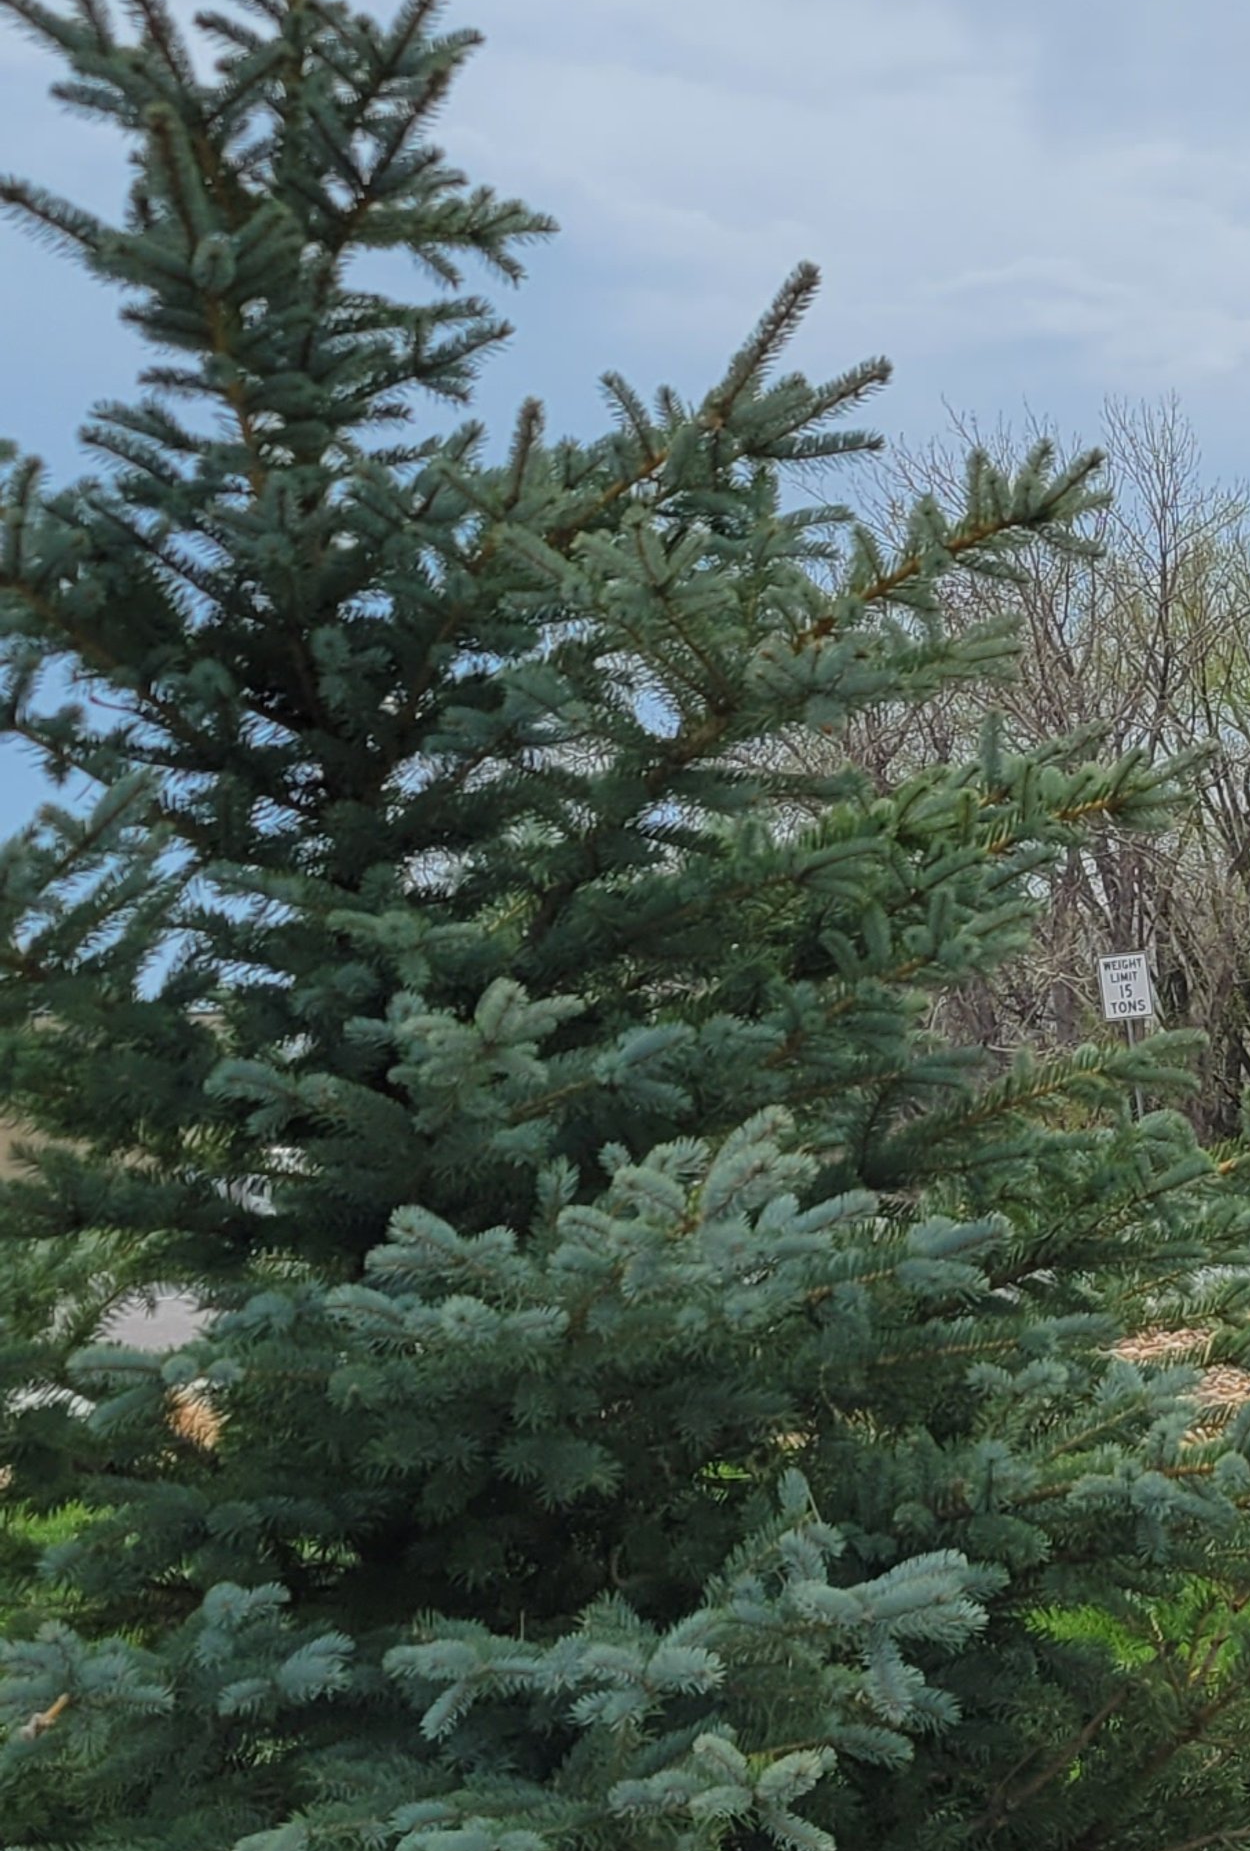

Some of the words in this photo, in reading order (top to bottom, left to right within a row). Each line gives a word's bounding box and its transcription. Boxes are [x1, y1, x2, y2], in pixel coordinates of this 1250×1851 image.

[1103, 958, 1142, 971] WEIGHT
[1110, 971, 1137, 983] LIMIT
[1119, 983, 1133, 999] 15
[1110, 999, 1147, 1014] TONS
